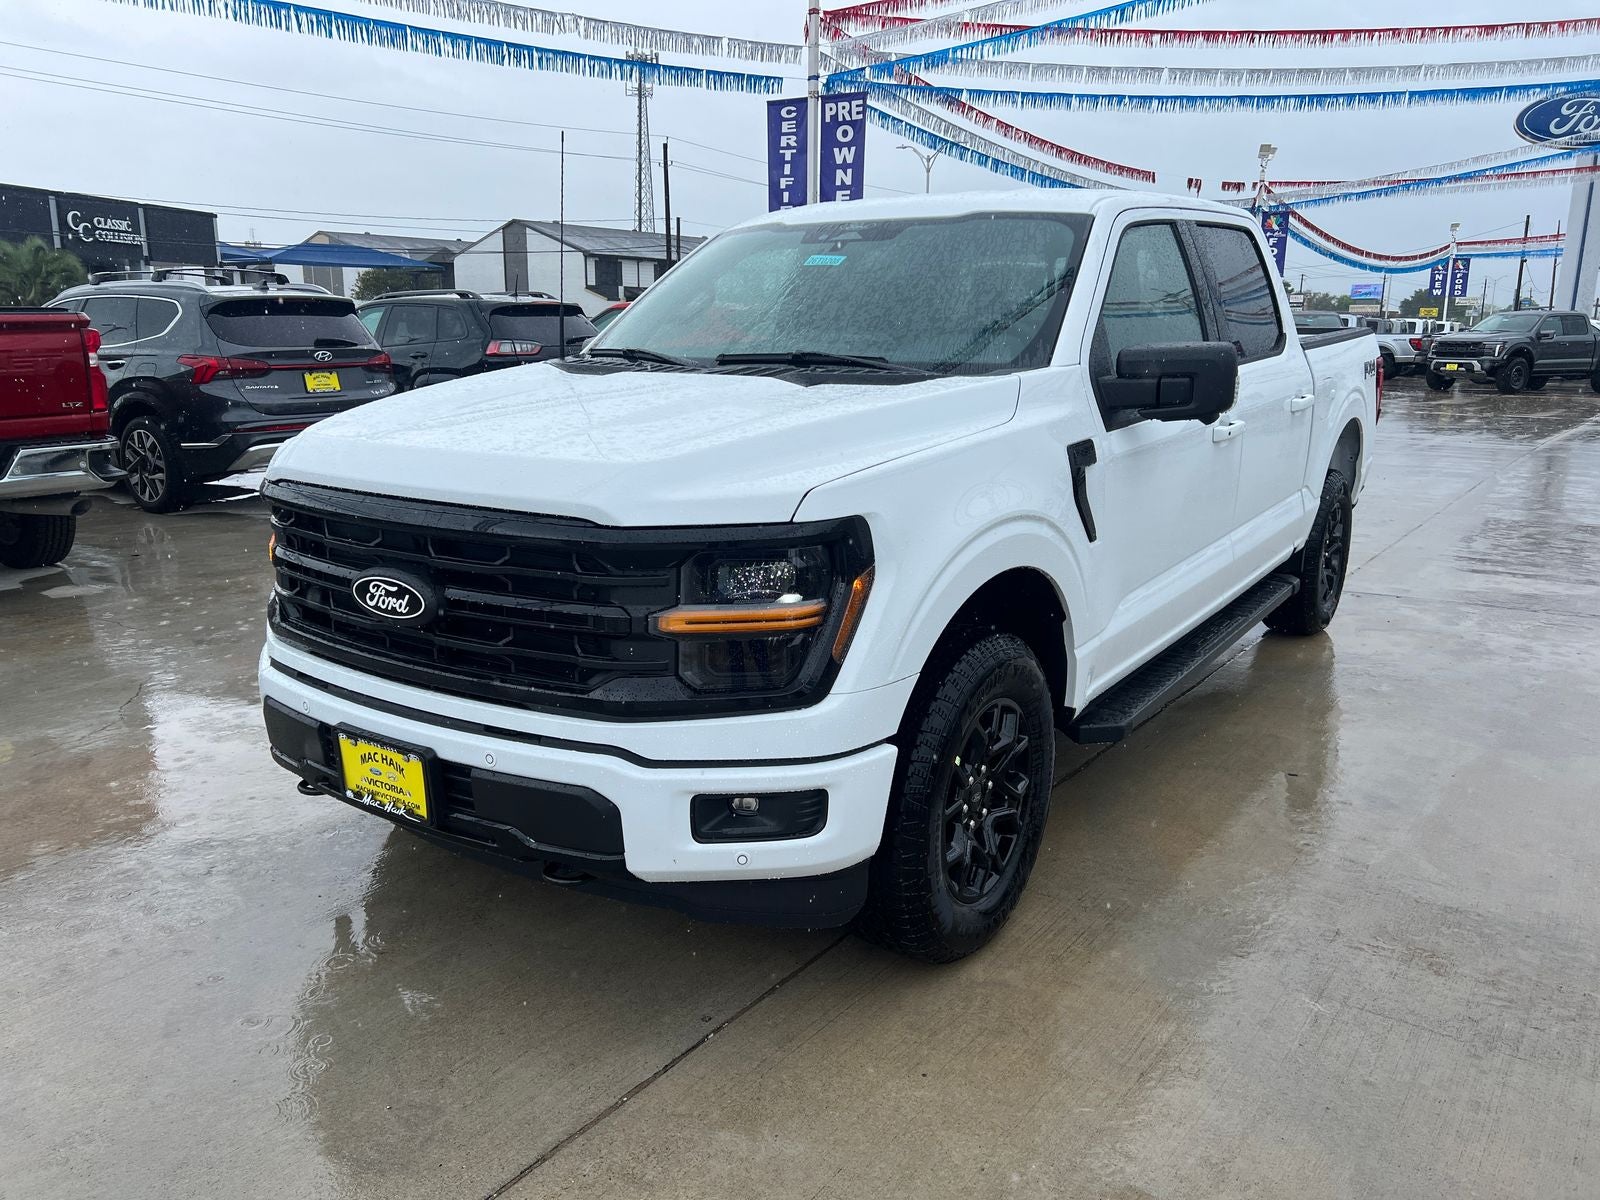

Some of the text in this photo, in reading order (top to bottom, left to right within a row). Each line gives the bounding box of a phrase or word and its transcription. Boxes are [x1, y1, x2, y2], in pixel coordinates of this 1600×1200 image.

[825, 100, 863, 122] PRE
[1549, 98, 1600, 134] Fo
[779, 106, 797, 209] CERTIFI
[833, 125, 856, 201] OWNE
[93, 217, 132, 231] CLASSIC
[95, 230, 145, 245] COLLISION
[1432, 274, 1443, 296] NEW
[1454, 273, 1463, 296] FORD
[366, 581, 410, 614] Ford
[360, 752, 379, 766] MAC
[381, 753, 406, 778] HAIK
[365, 777, 406, 796] VICTORIA
[362, 793, 410, 818] Mac Haik
